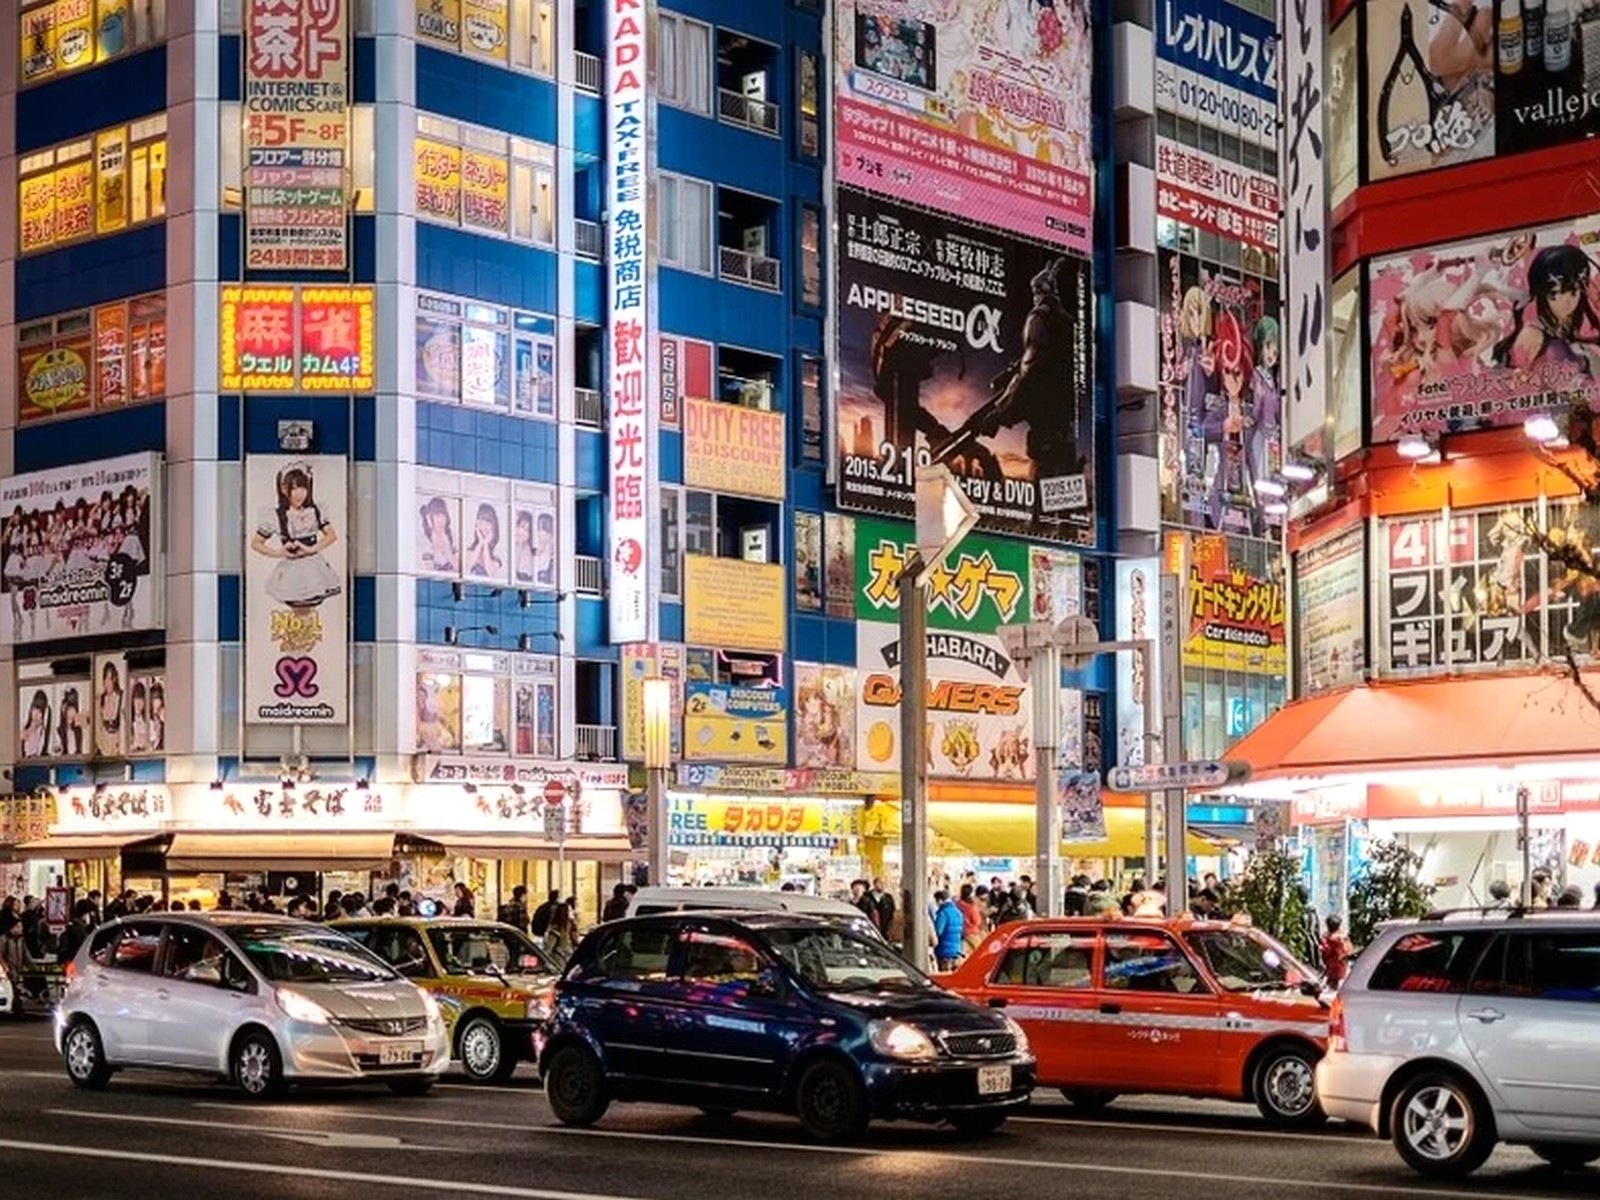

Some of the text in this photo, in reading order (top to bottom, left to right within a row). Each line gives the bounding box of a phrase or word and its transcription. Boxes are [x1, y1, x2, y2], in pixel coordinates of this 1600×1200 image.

[250, 0, 302, 78] 茶
[250, 248, 342, 265] 24時間営業
[614, 208, 642, 311] 免税商店
[847, 282, 965, 332] APPLESEED
[686, 402, 782, 450] DUTY FREE
[1005, 479, 1035, 507] DVD
